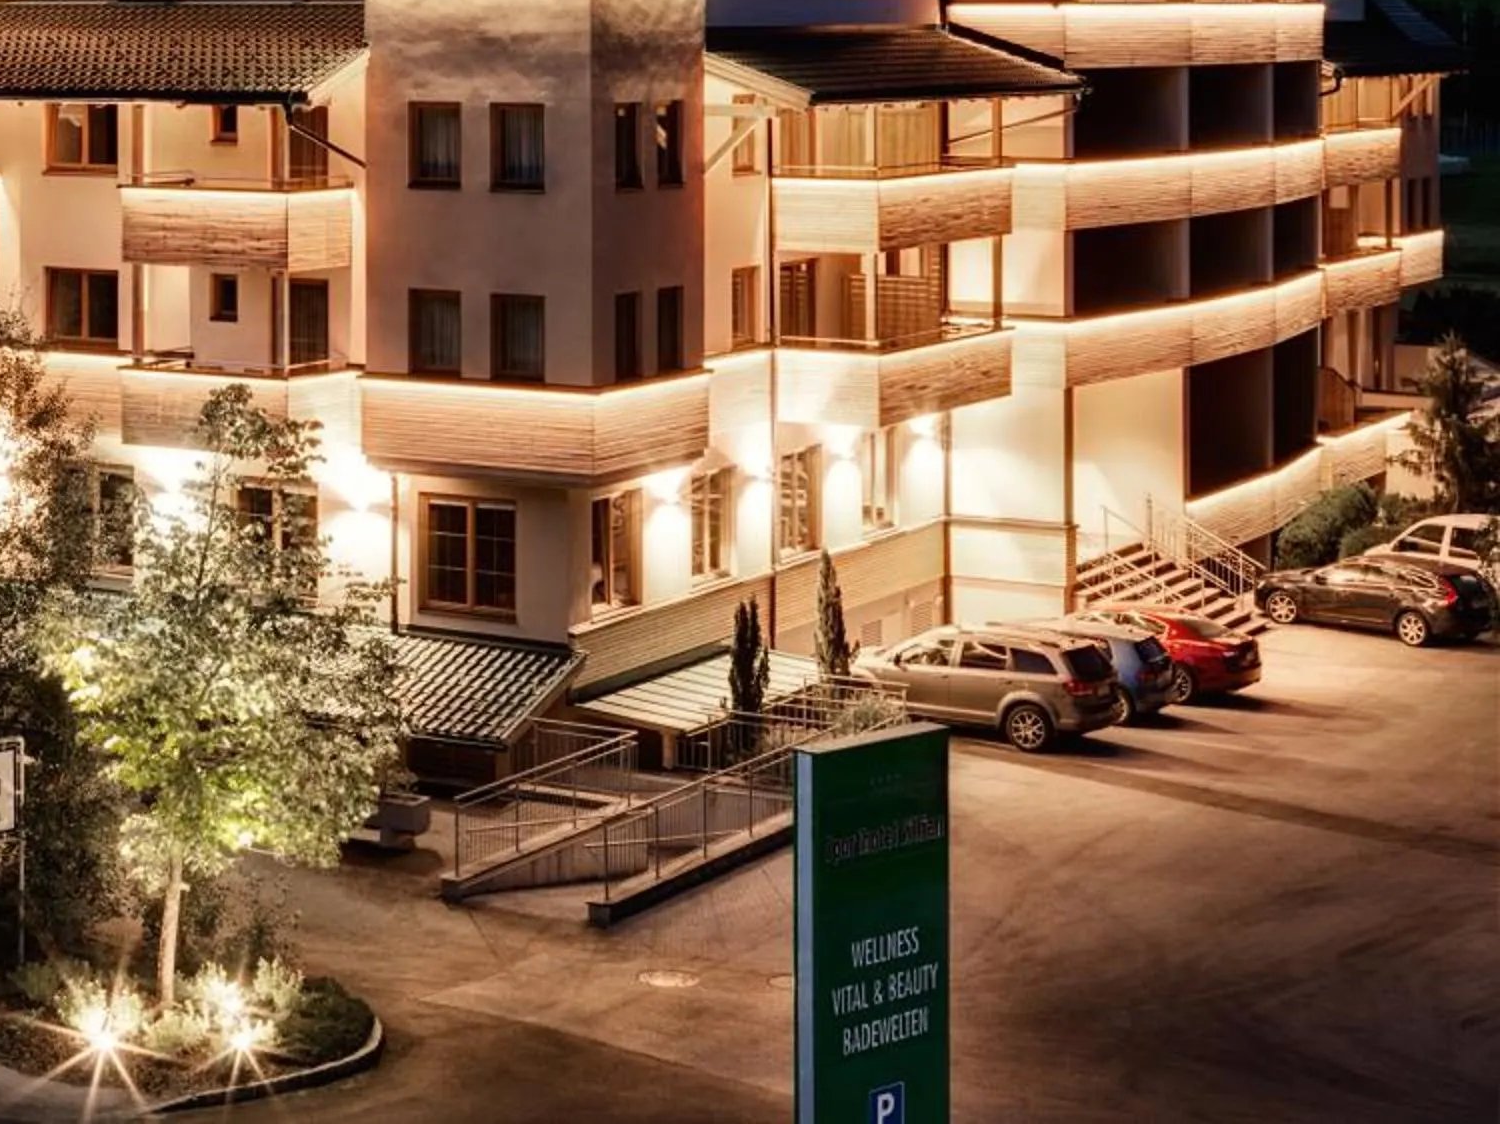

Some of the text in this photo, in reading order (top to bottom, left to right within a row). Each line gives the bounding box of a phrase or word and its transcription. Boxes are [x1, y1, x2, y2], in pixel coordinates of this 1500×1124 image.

[851, 926, 919, 968] WELLNESS
[831, 961, 939, 1016] VITAL & BEAUTY
[843, 1005, 929, 1057] BADEWELTEN
[876, 1091, 895, 1124] P
